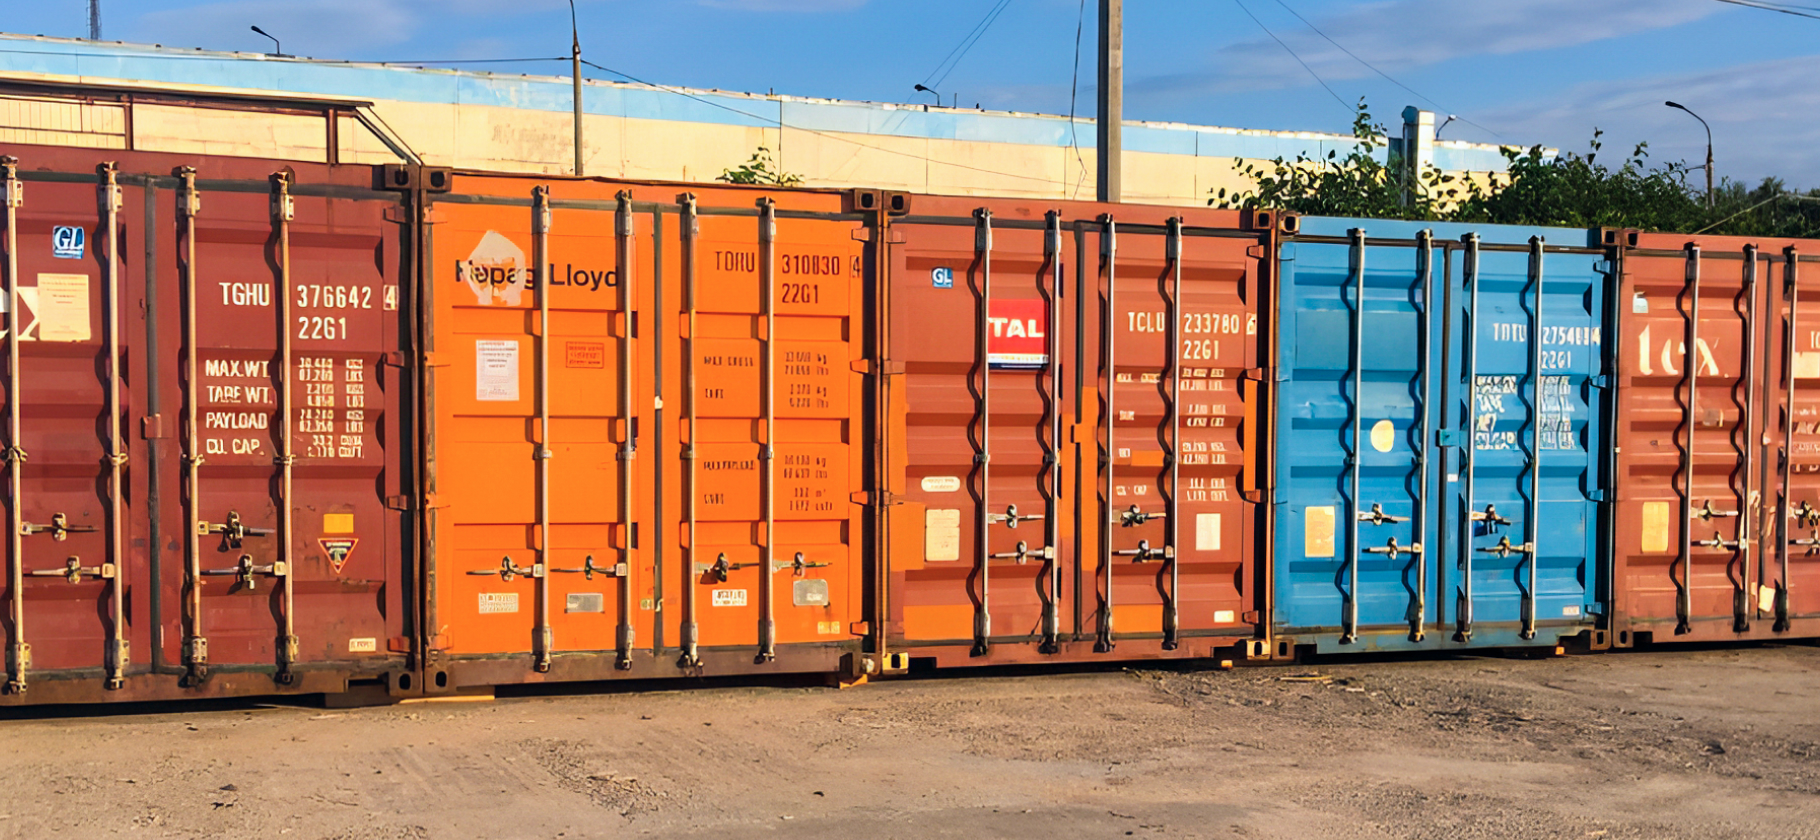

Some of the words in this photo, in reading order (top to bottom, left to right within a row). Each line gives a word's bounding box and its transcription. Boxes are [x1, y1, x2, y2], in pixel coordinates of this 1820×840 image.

[55, 228, 83, 250] GL
[782, 254, 840, 276] 310830
[550, 264, 618, 291] Lloyd
[932, 268, 952, 284] GL
[219, 282, 270, 306] TGHU
[297, 285, 372, 308] 376642
[385, 286, 397, 310] 4
[782, 283, 818, 304] 22G1
[298, 316, 346, 339] 22G1
[988, 317, 1045, 338] TAL
[1128, 312, 1165, 332] TCLU
[1184, 313, 1240, 334] 233780
[1183, 339, 1219, 360] 22G1
[207, 386, 241, 403] TARE
[206, 412, 268, 429] PAYLOAD
